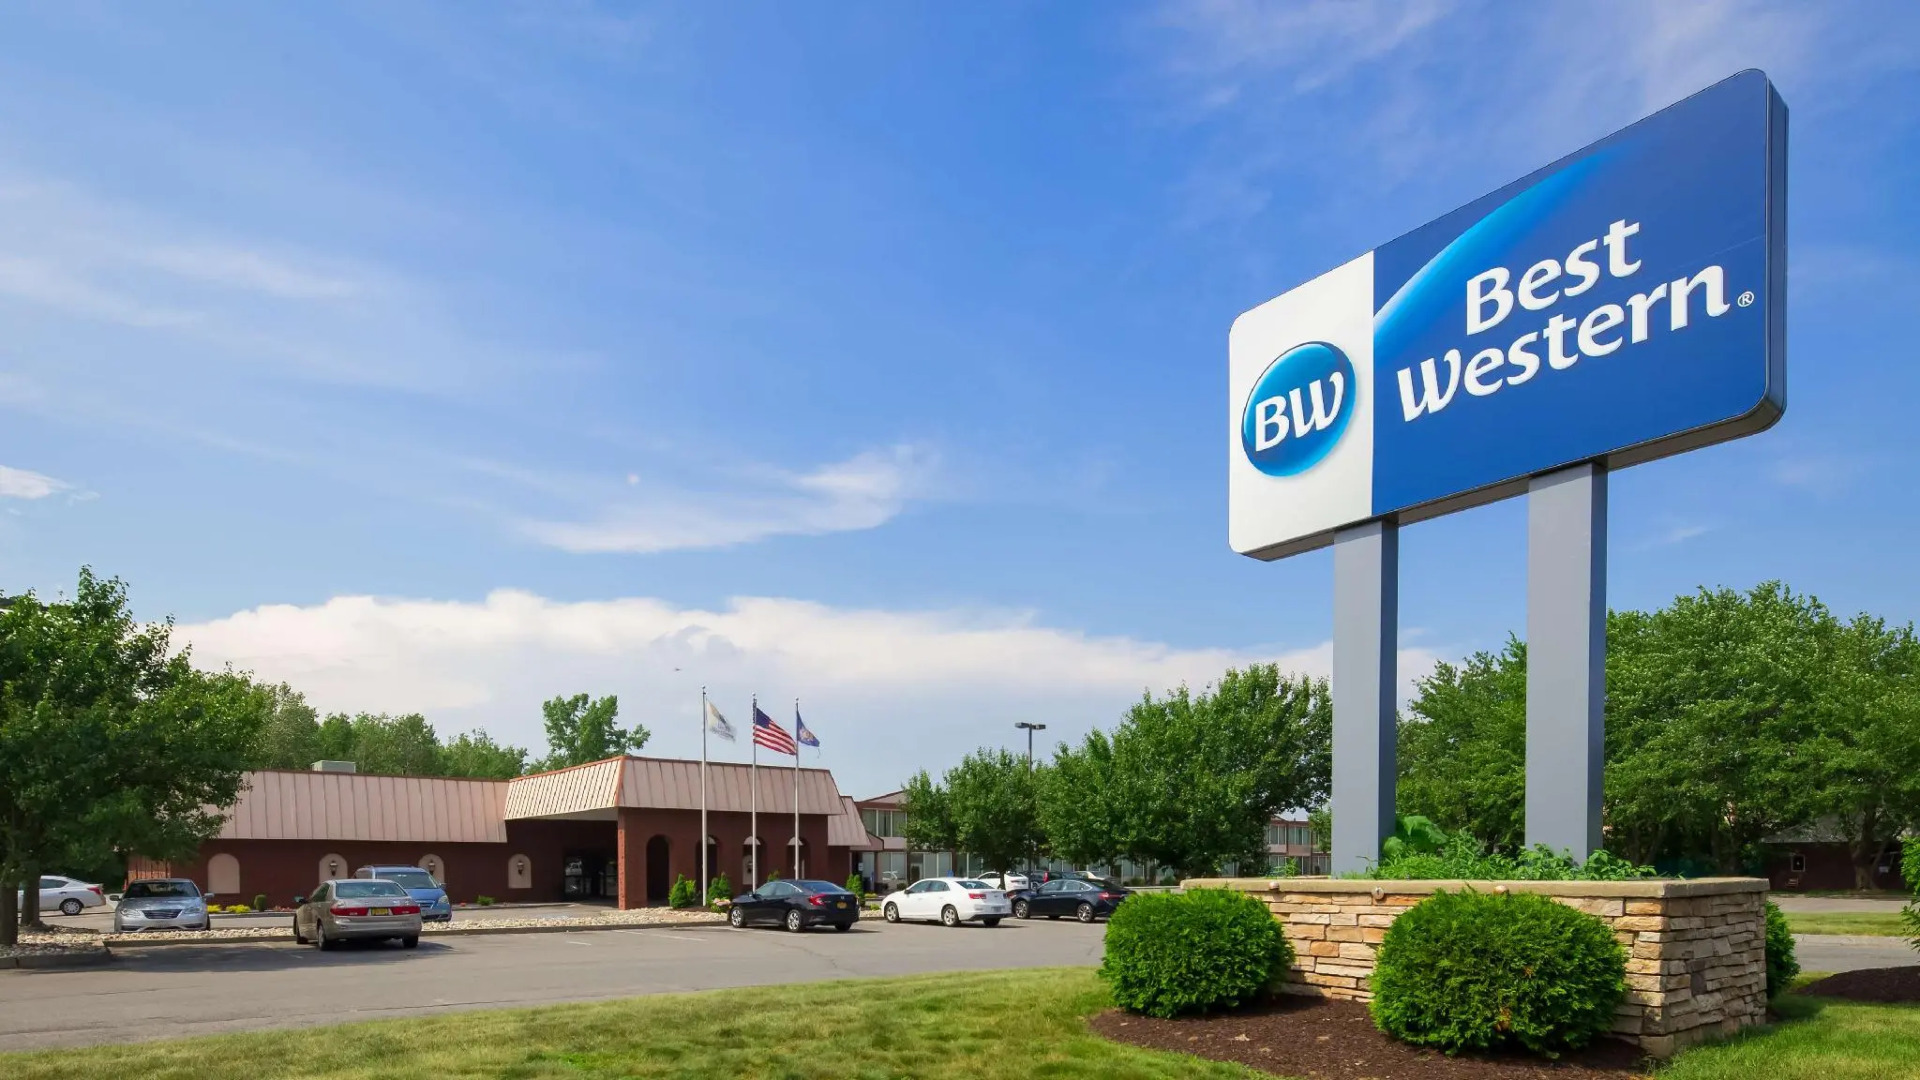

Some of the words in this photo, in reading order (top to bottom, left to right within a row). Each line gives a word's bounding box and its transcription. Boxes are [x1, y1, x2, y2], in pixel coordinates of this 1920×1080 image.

[1466, 219, 1642, 336] Best
[1397, 265, 1731, 422] Western
[1254, 370, 1345, 452] BW
